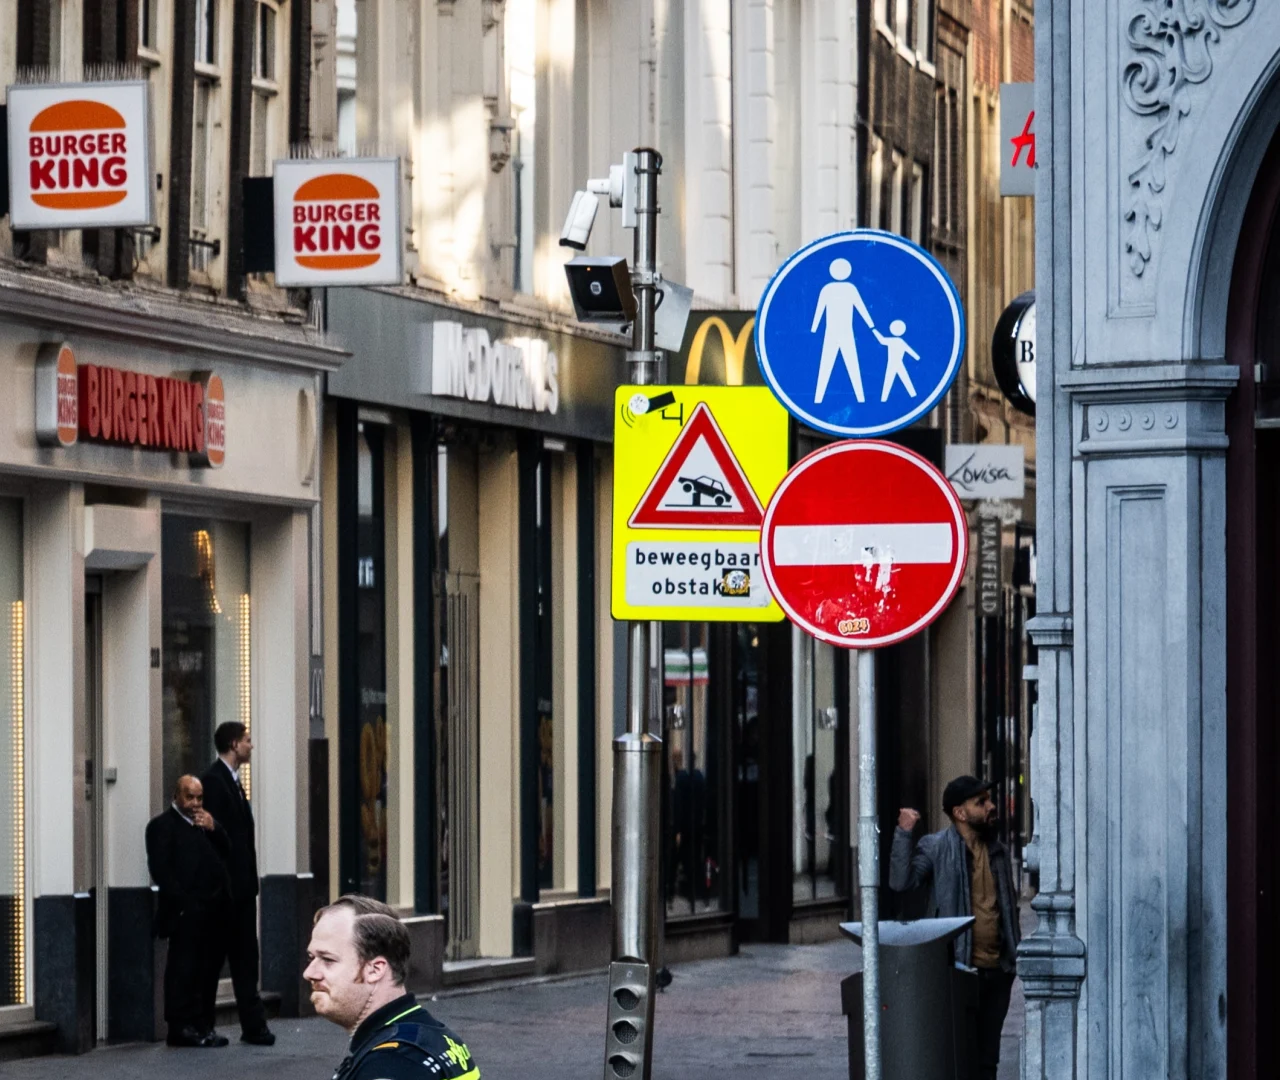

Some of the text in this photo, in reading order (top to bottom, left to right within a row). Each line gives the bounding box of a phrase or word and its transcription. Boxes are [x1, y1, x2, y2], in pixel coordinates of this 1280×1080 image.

[29, 132, 127, 157] BURGER
[29, 157, 128, 190] KING
[293, 202, 381, 223] BURGER
[293, 224, 382, 252] KING
[58, 397, 77, 425] KING
[87, 363, 204, 453] BURGER KING
[207, 422, 225, 447] KING
[947, 452, 1015, 492] Lovisa
[636, 549, 760, 571] beweegbaar
[981, 521, 997, 613] MANFIELD
